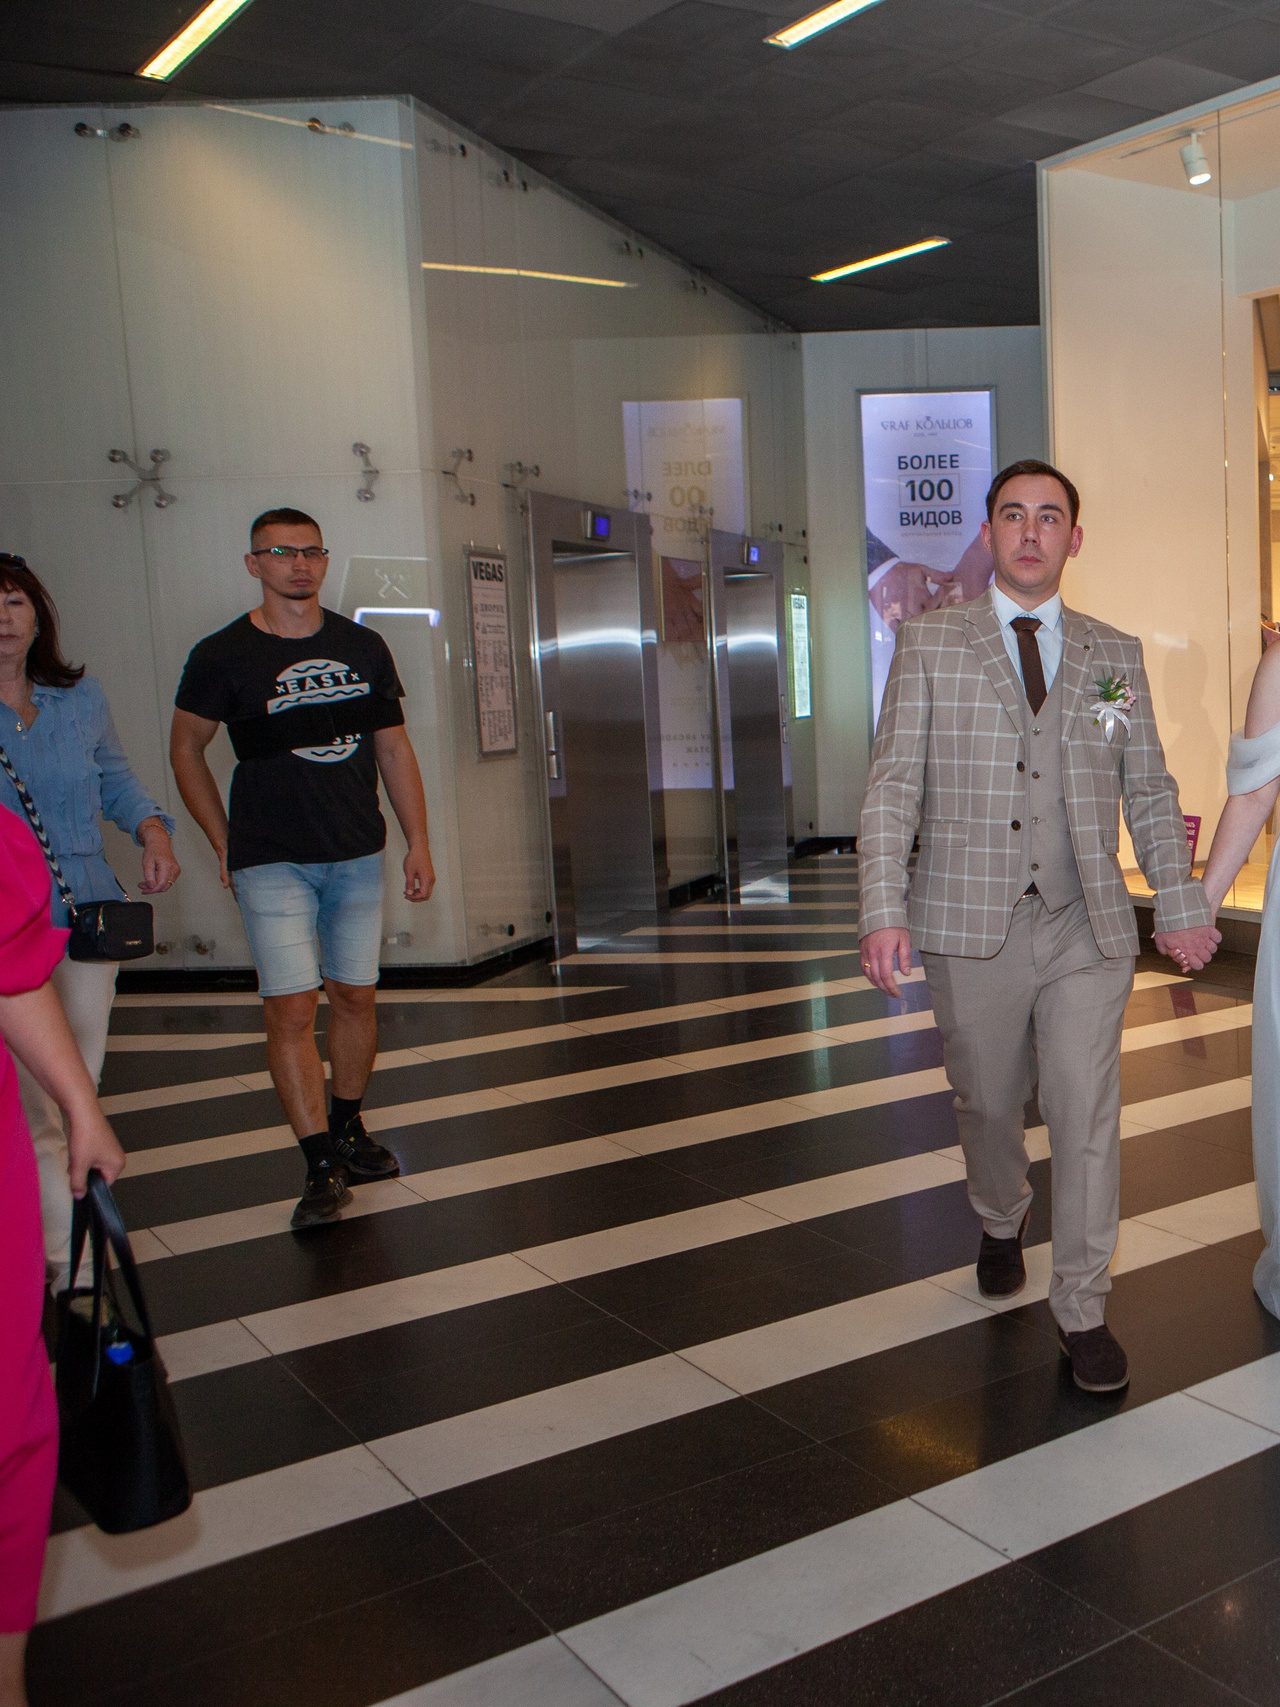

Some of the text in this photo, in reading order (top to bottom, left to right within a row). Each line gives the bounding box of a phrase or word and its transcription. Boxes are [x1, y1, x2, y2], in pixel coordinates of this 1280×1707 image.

[897, 454, 960, 470] БОЛЕЕ
[905, 478, 954, 502] 100
[899, 510, 963, 528] ВИДОВ
[471, 560, 504, 582] VEGAS
[285, 671, 348, 694] EAST
